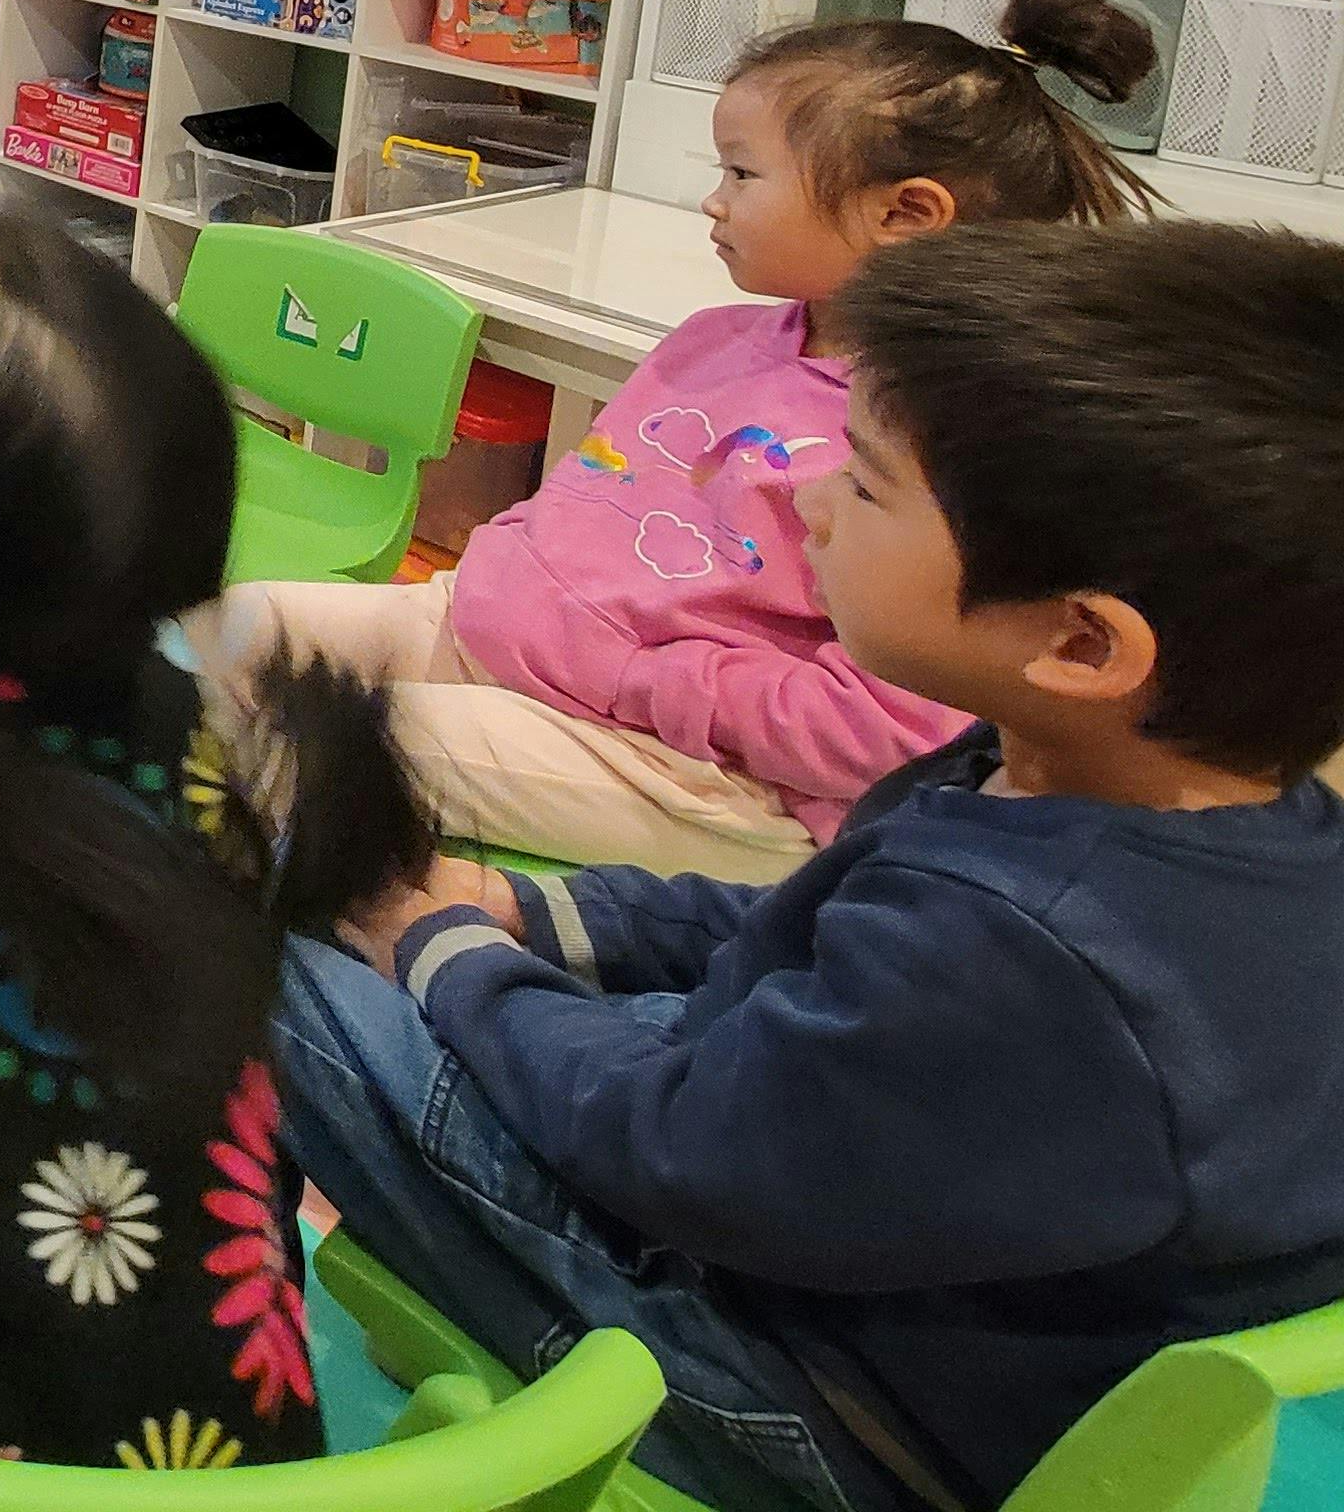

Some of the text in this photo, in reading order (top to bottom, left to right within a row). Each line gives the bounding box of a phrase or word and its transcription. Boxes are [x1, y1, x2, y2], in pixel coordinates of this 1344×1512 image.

[57, 94, 100, 114] Busy Barn
[7, 133, 44, 163] Barbie
